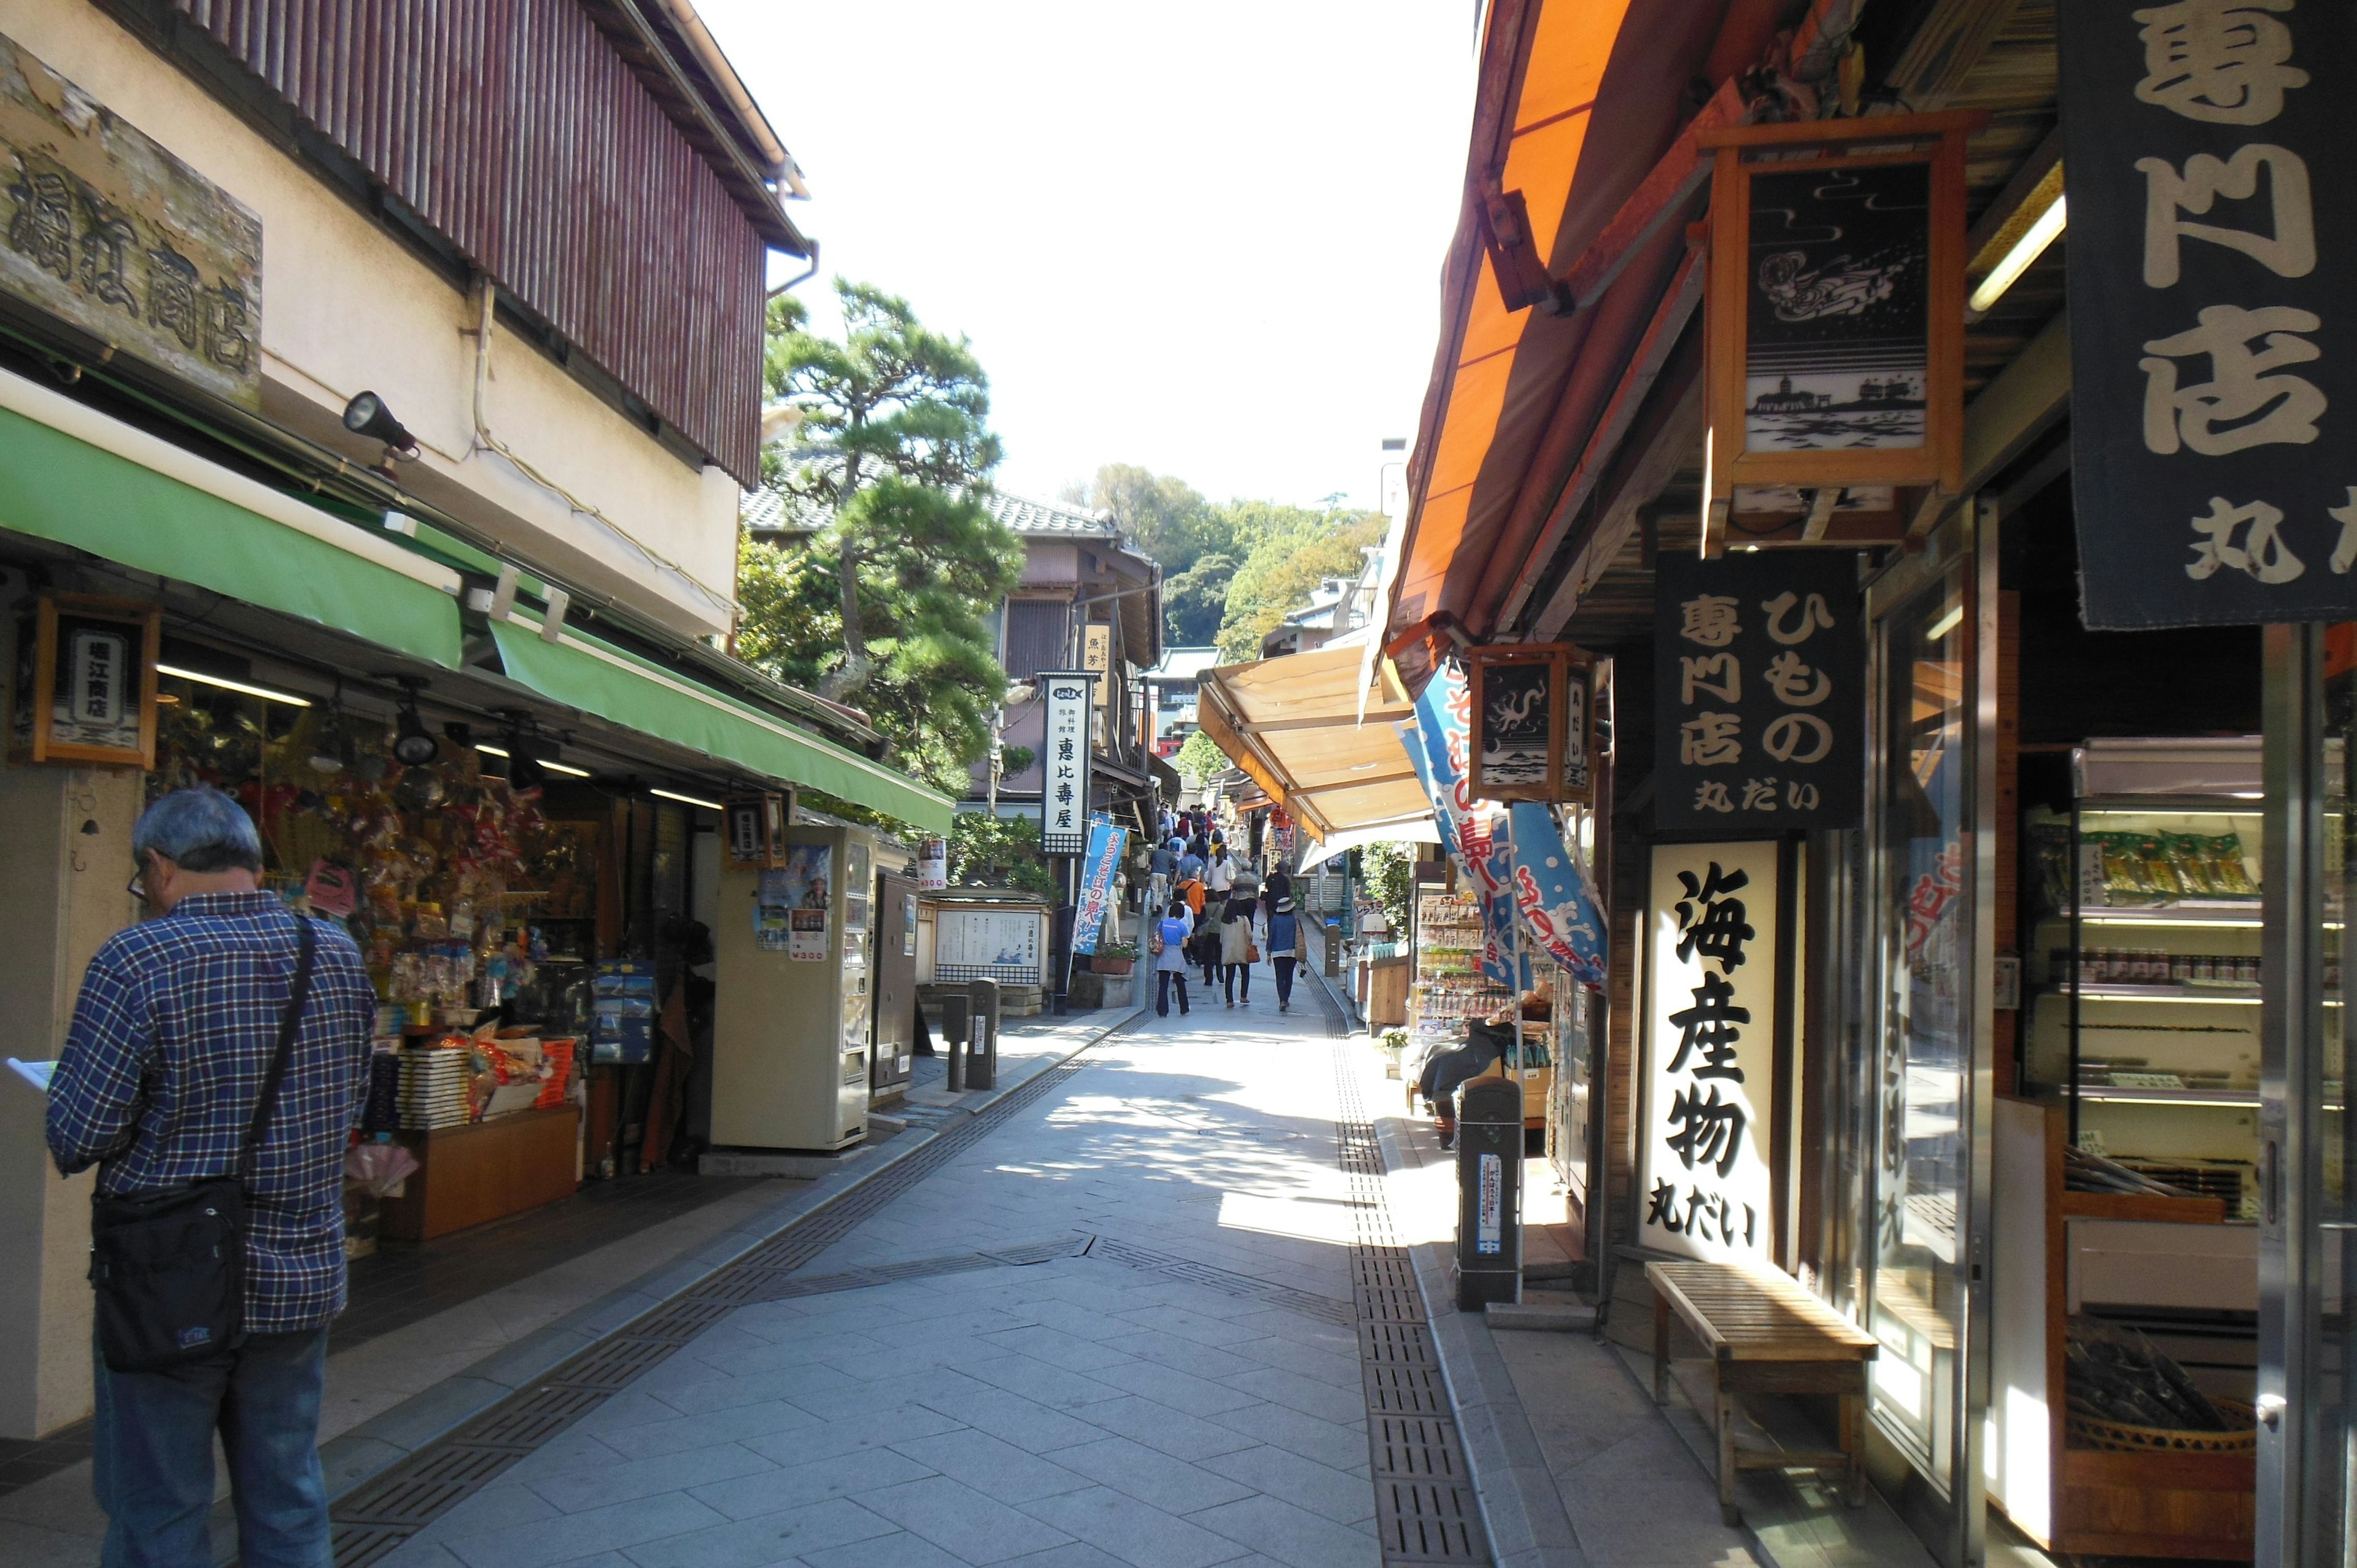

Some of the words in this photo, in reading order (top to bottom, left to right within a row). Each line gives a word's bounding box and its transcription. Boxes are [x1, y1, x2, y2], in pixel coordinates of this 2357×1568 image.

[88, 641, 109, 719] 堀江商店
[1679, 592, 1743, 766] 専門店
[1761, 590, 1835, 763] ひもの
[1571, 685, 1581, 759] 丸だい
[1693, 777, 1819, 813] 丸だい
[1666, 860, 1755, 1179] 海産物
[1646, 1175, 1757, 1249] 丸だい
